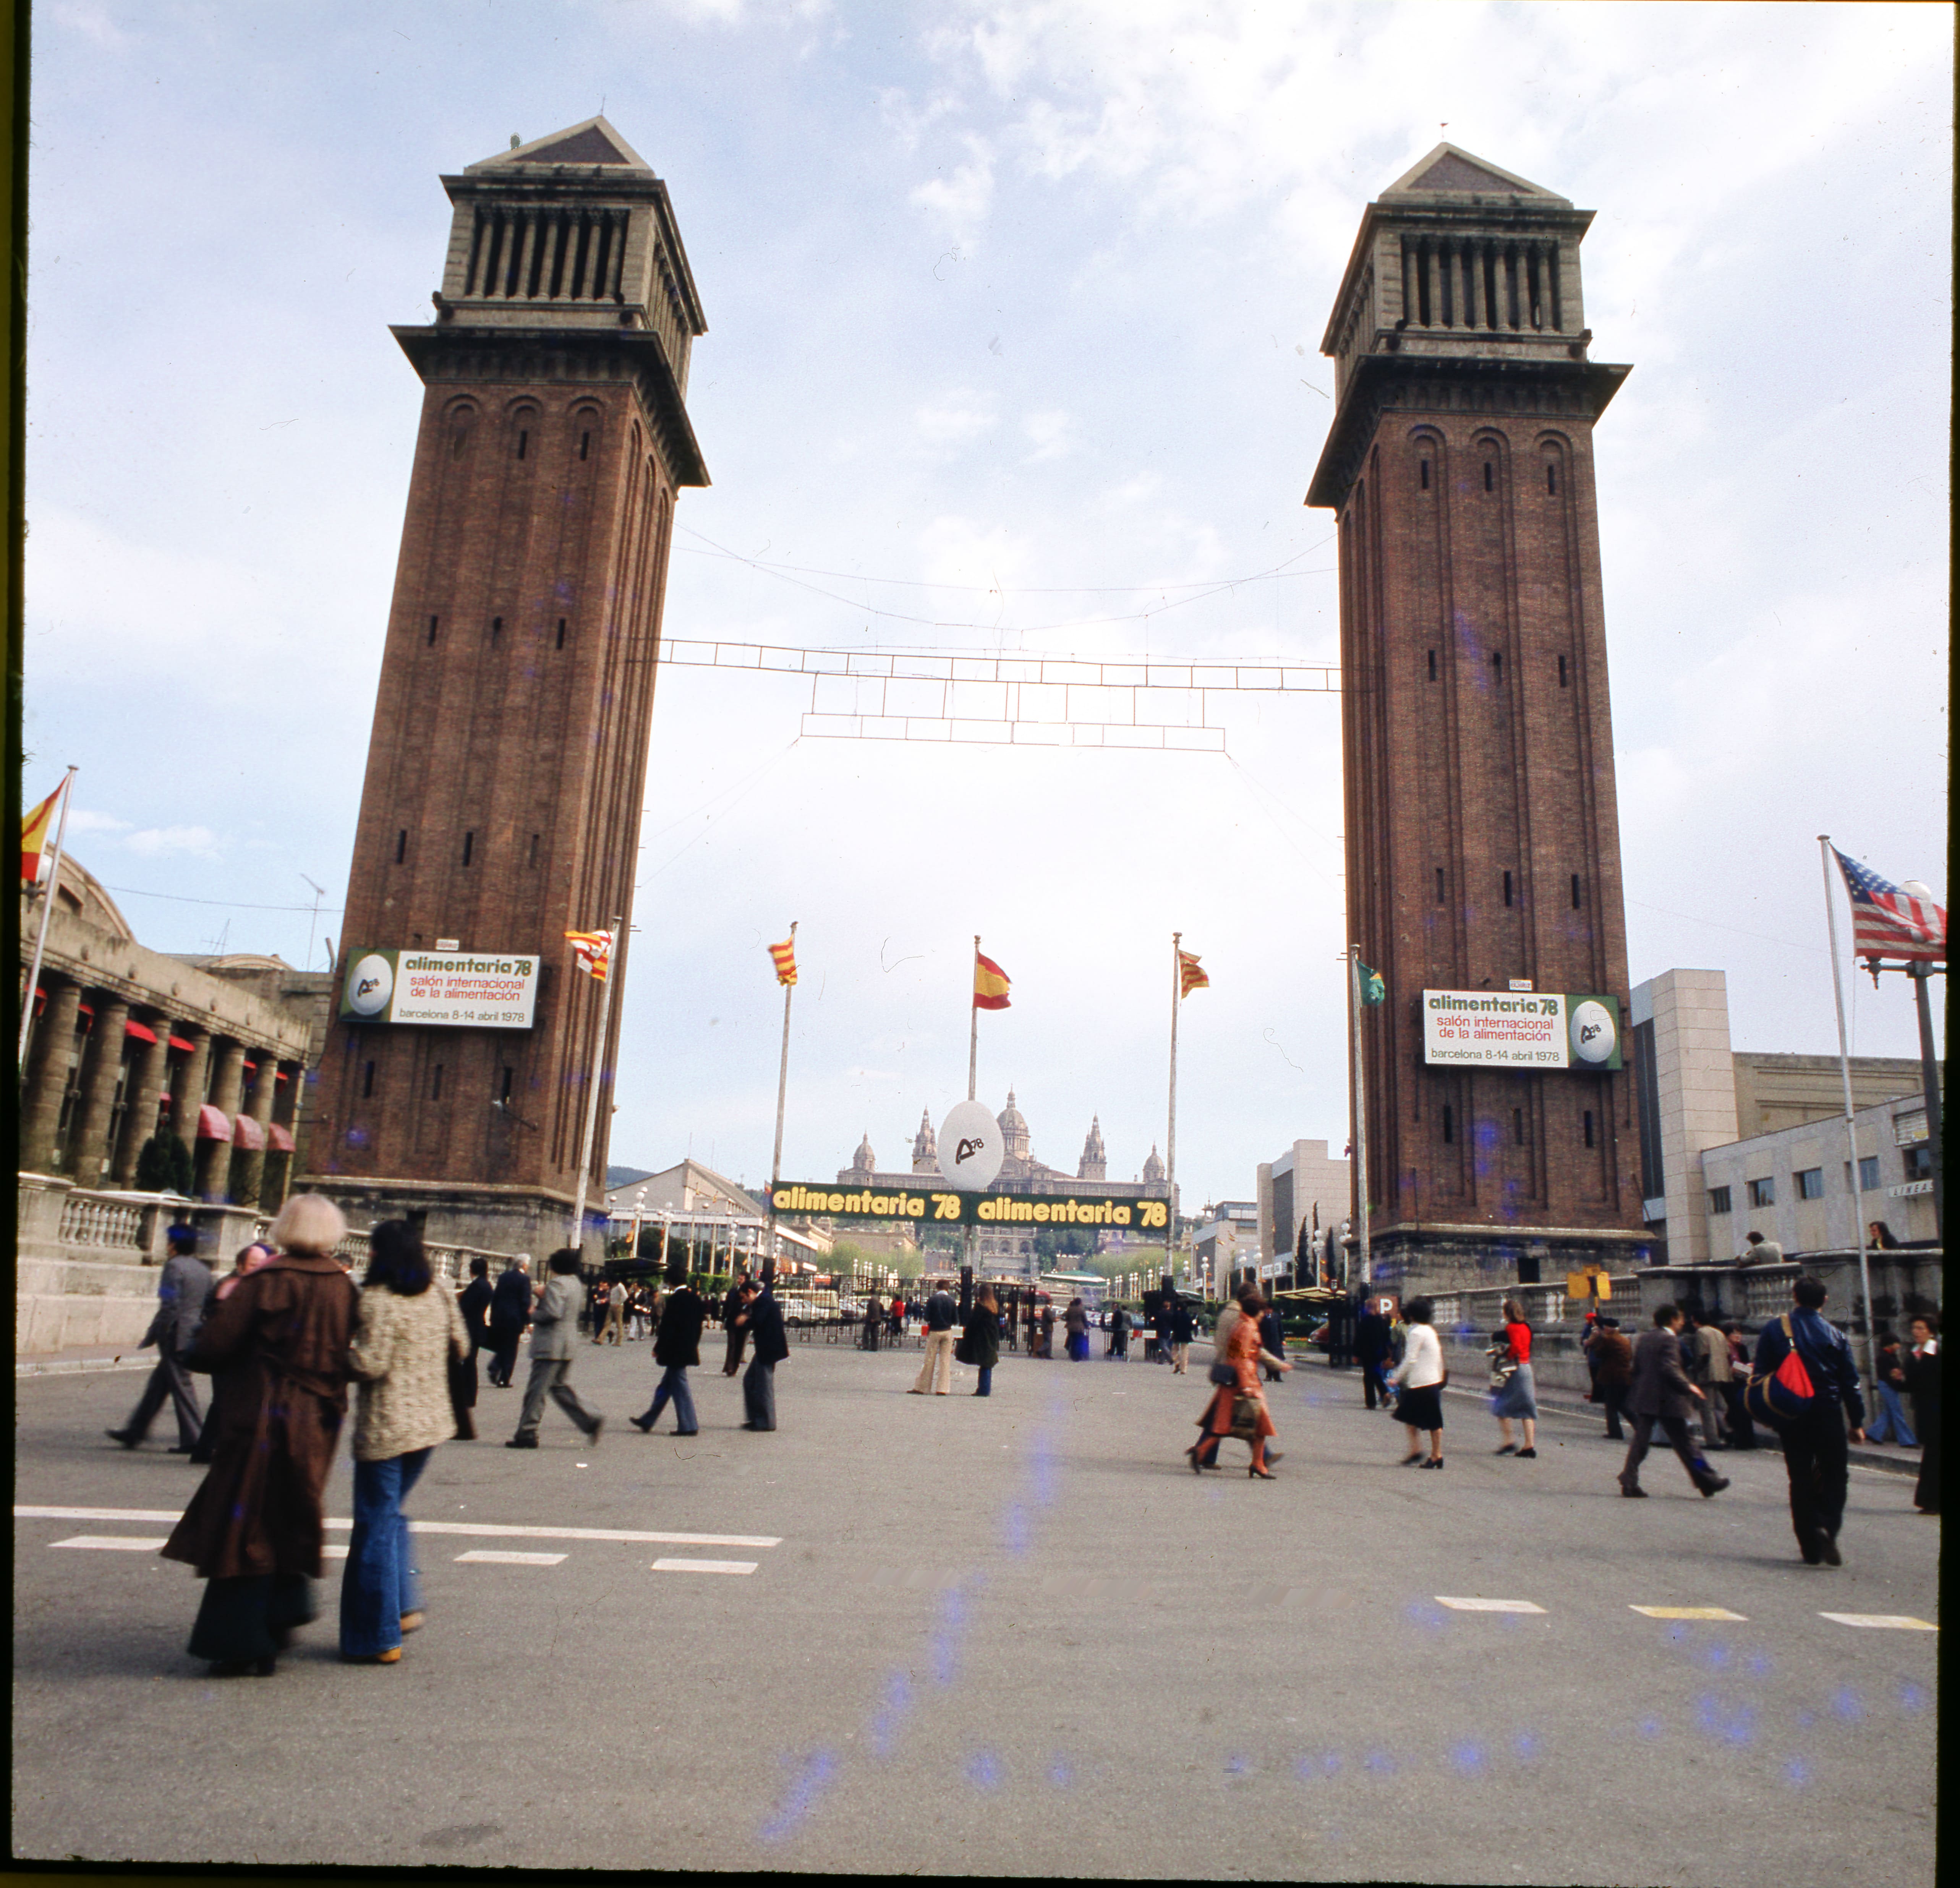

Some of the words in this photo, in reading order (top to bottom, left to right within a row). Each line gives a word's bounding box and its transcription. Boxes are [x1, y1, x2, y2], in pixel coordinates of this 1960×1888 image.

[405, 957, 511, 974] alimentaria
[514, 959, 532, 976] 78
[410, 976, 442, 987] salón
[447, 976, 525, 989] internacional
[411, 987, 425, 997] de
[430, 987, 440, 998] la
[445, 988, 520, 1001] alimentación
[1429, 995, 1537, 1013] alimentaria
[1539, 998, 1558, 1016] 78
[400, 1008, 449, 1019] barcelona
[478, 1011, 498, 1021] abril
[501, 1012, 525, 1022] 1978
[1437, 1015, 1470, 1027] salón
[1474, 1016, 1553, 1029] internacional
[1439, 1027, 1454, 1038] de
[1459, 1027, 1469, 1039] la
[1474, 1028, 1551, 1041] alimentación
[1432, 1048, 1482, 1059] barcelona
[1512, 1050, 1532, 1060] abril
[1536, 1052, 1559, 1061] 1978
[773, 1186, 925, 1217] alimentaria
[931, 1193, 961, 1219] 78
[978, 1197, 1131, 1225] alimentaria
[1137, 1201, 1167, 1227] 78
[1380, 1298, 1393, 1314] P
